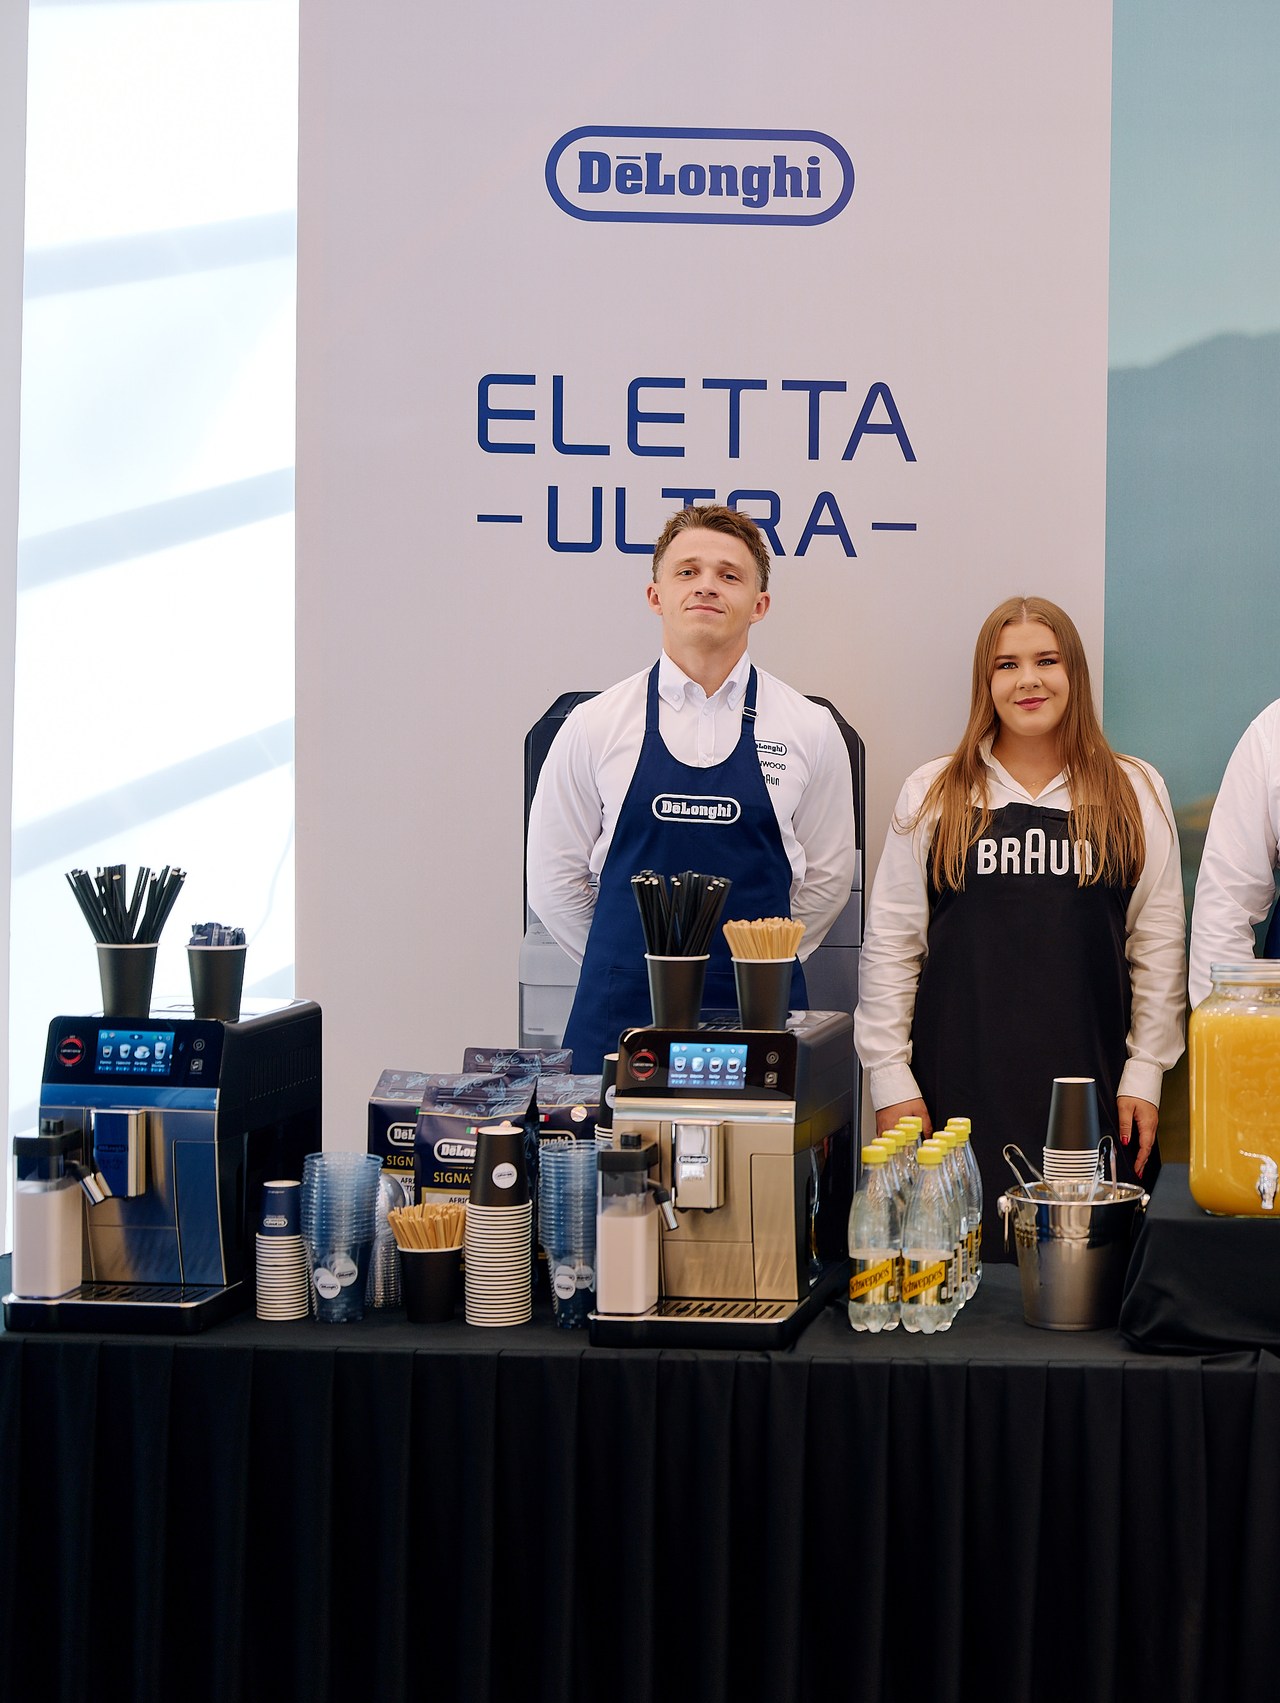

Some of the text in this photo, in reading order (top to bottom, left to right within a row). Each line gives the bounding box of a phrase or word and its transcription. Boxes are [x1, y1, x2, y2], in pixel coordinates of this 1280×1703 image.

[477, 374, 917, 461] ELETTA
[757, 743, 783, 753] Longhi
[977, 829, 1093, 875] BRAUN
[433, 1171, 472, 1184] SIGNA
